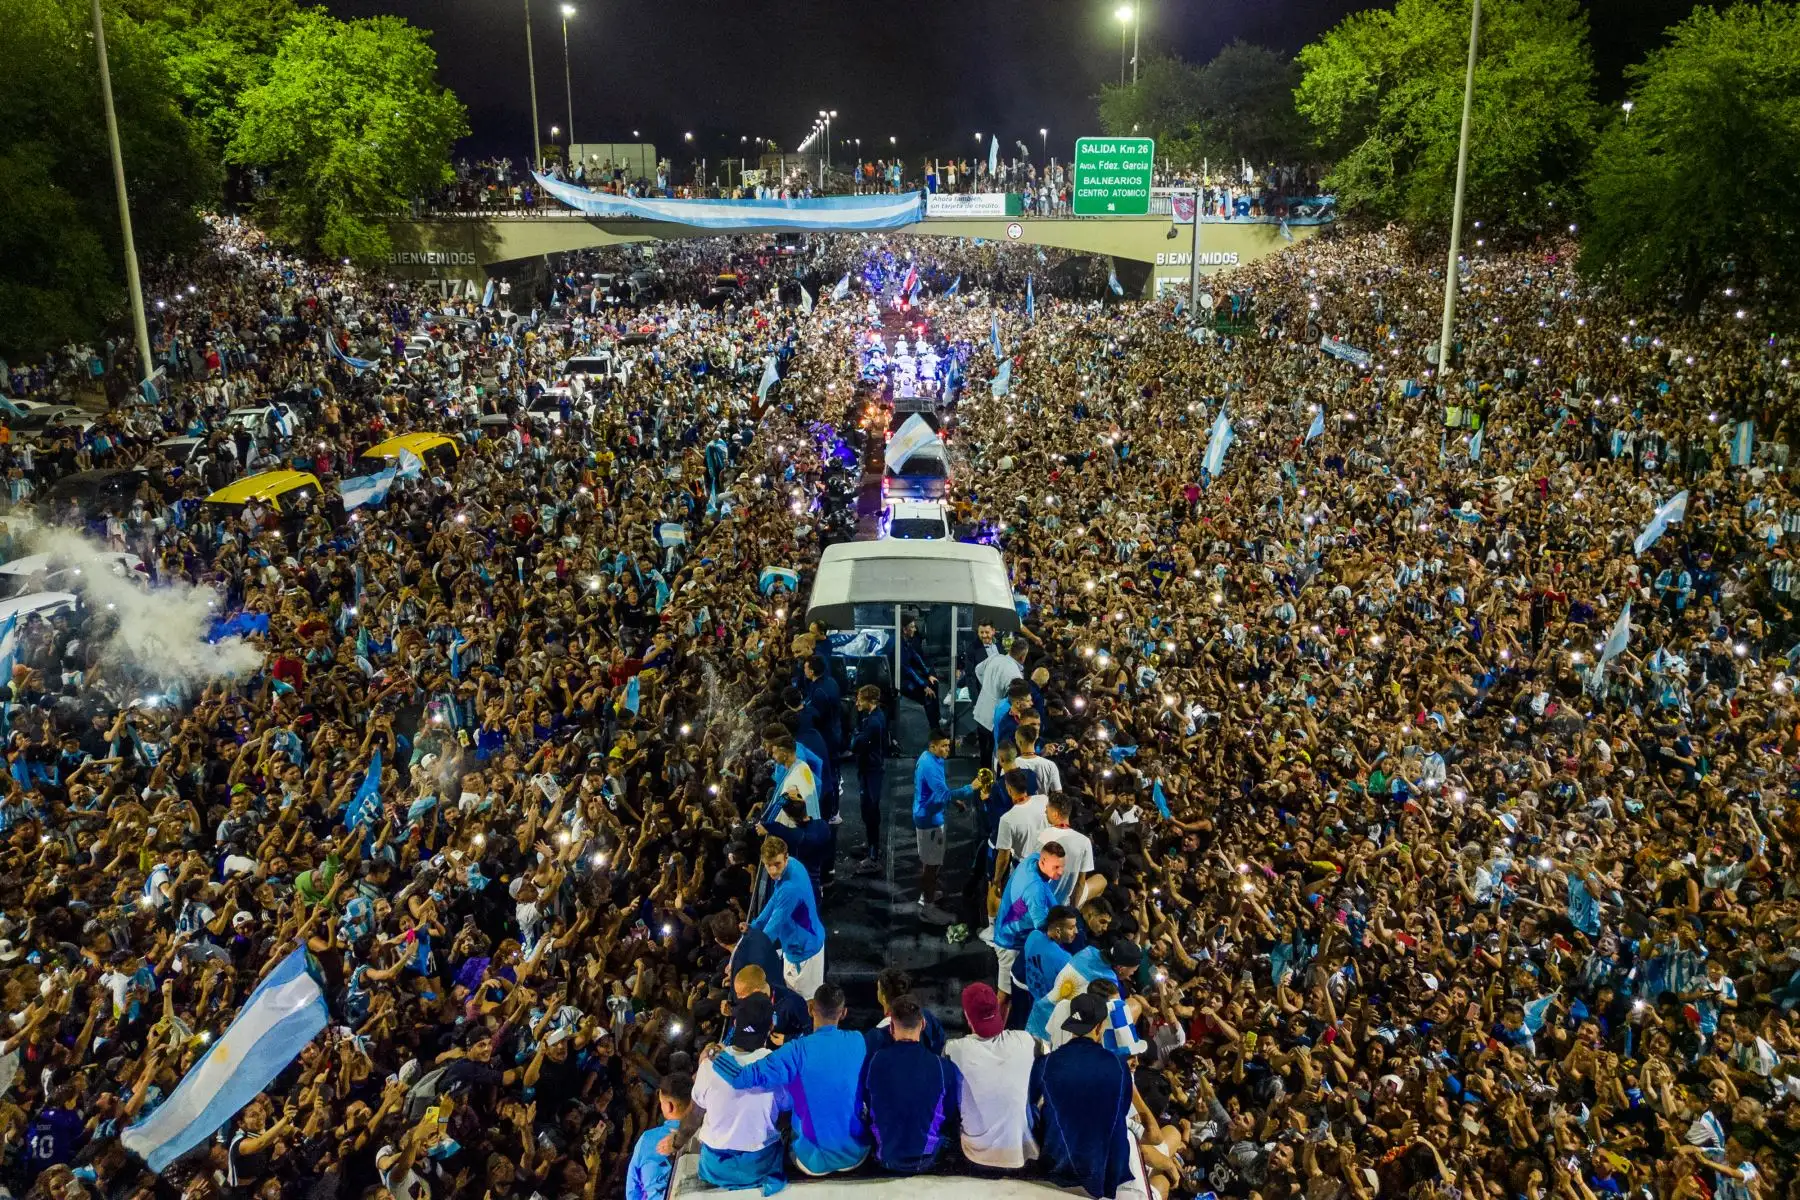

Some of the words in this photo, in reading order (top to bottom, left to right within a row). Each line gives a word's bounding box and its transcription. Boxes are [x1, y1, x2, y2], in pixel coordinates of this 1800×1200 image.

[1081, 144, 1116, 154] SALIDA
[1120, 145, 1135, 154] Km
[1138, 145, 1148, 154] 26
[1083, 176, 1142, 185] BALNEARIOS
[1078, 189, 1109, 197] CENTRO
[1112, 189, 1146, 197] ATOMICO
[389, 252, 476, 265] BIENVENIDOS
[1156, 252, 1238, 265] BIENVNIDOS
[31, 1135, 54, 1159] 10
